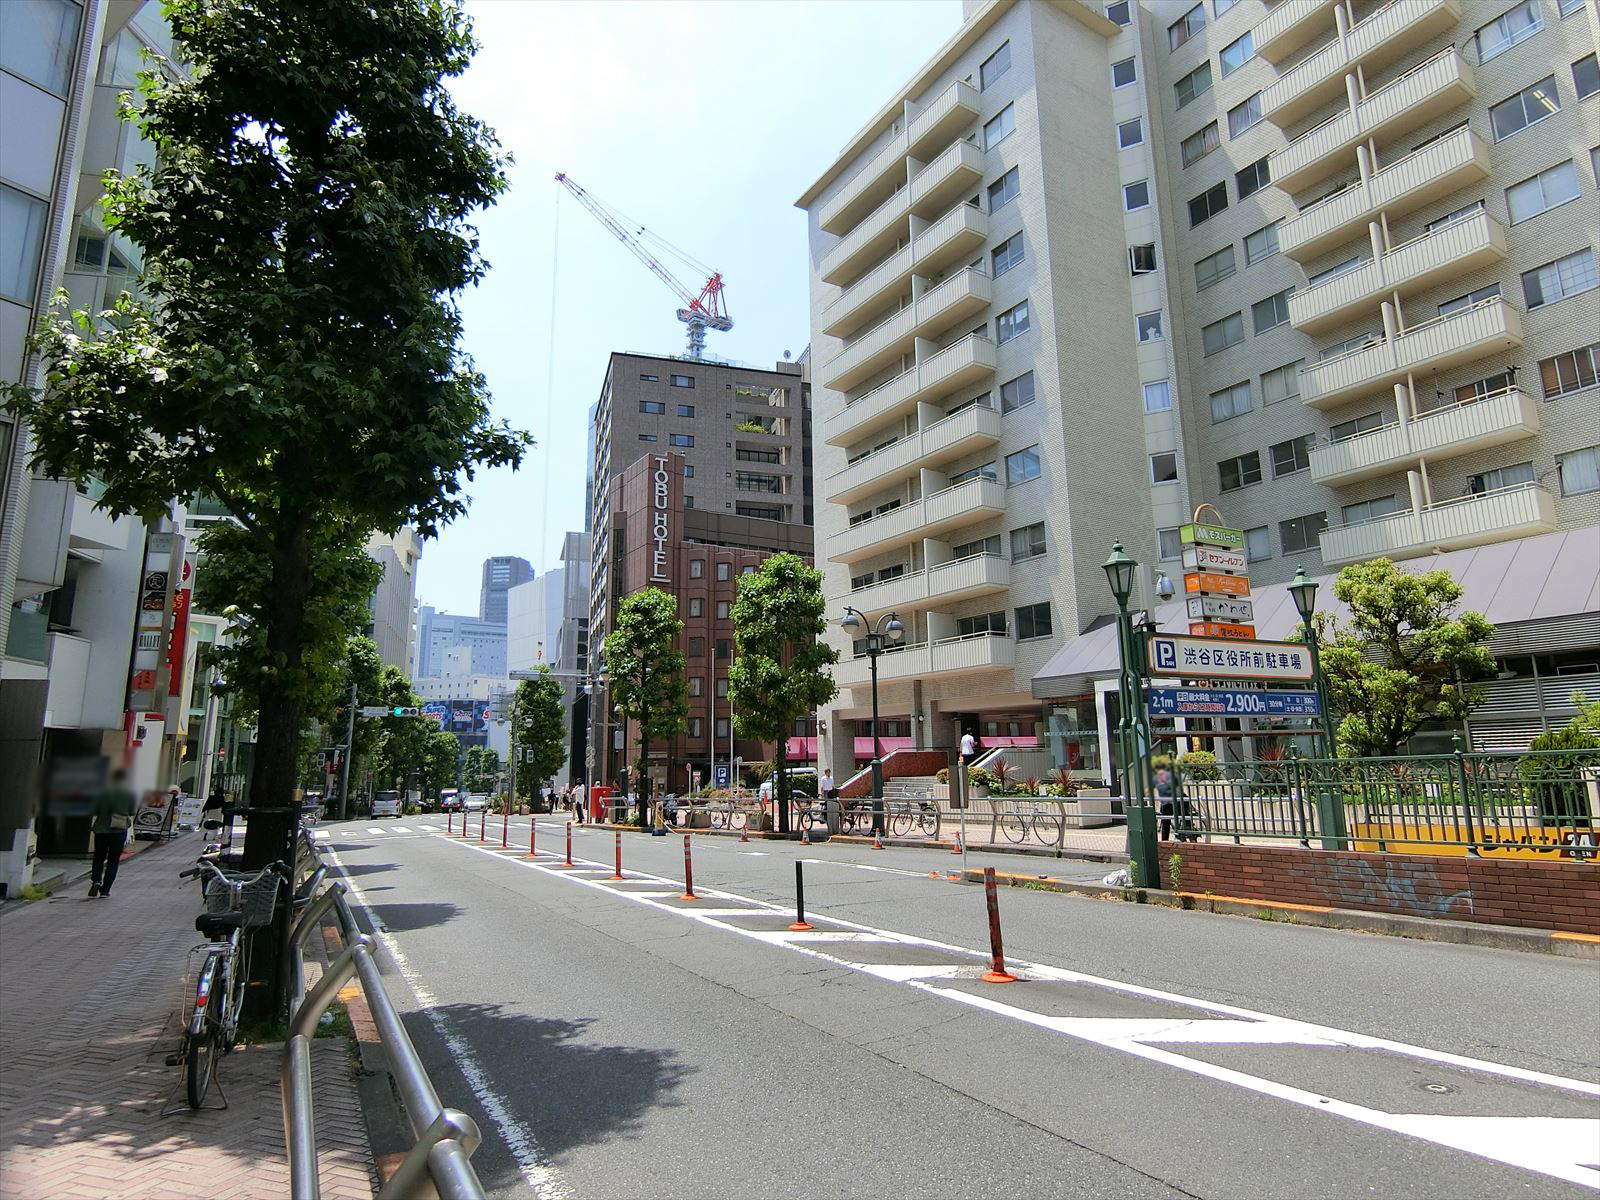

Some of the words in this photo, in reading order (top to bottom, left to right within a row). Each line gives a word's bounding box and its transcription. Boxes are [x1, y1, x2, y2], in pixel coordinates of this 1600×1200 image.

[655, 458, 669, 509] TOBU
[653, 512, 668, 577] HOTEL
[1183, 647, 1302, 670] 渋谷区役所前駐車場
[1152, 696, 1173, 708] 2.1m
